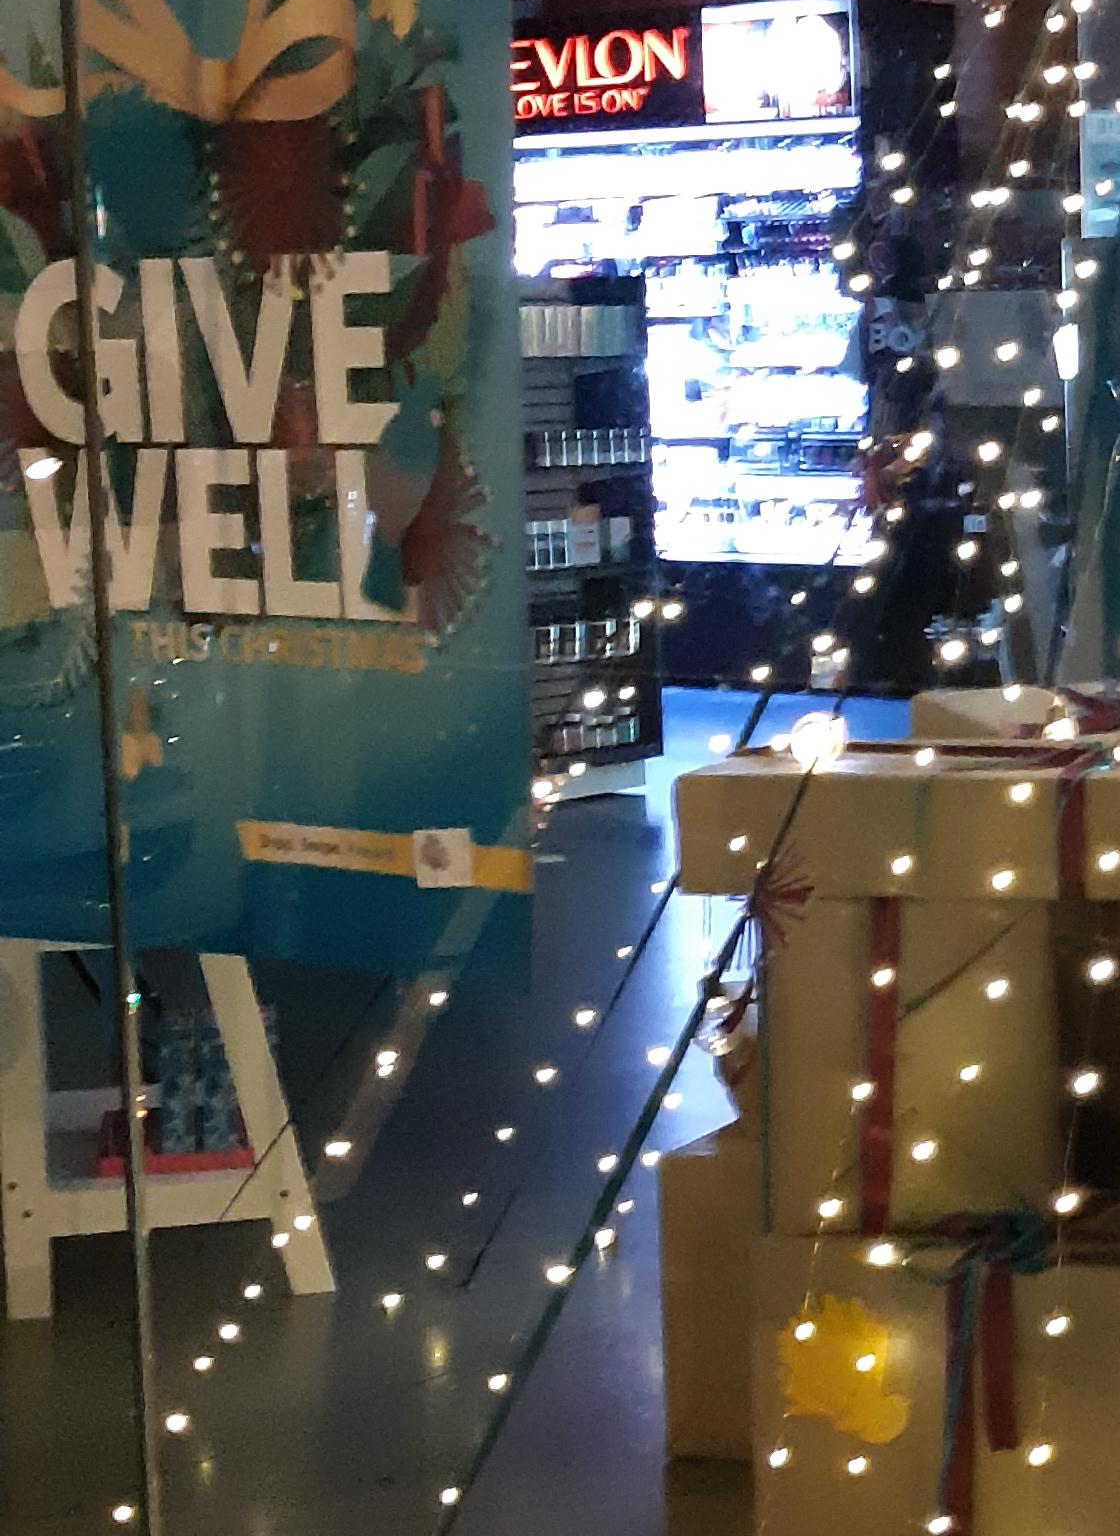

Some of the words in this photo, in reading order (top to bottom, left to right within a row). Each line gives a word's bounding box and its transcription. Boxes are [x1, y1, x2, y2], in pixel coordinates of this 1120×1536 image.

[513, 91, 571, 120] OVE
[573, 90, 599, 114] IS
[13, 250, 400, 445] GIVE
[18, 447, 418, 624] WELL
[128, 619, 210, 663] THIS
